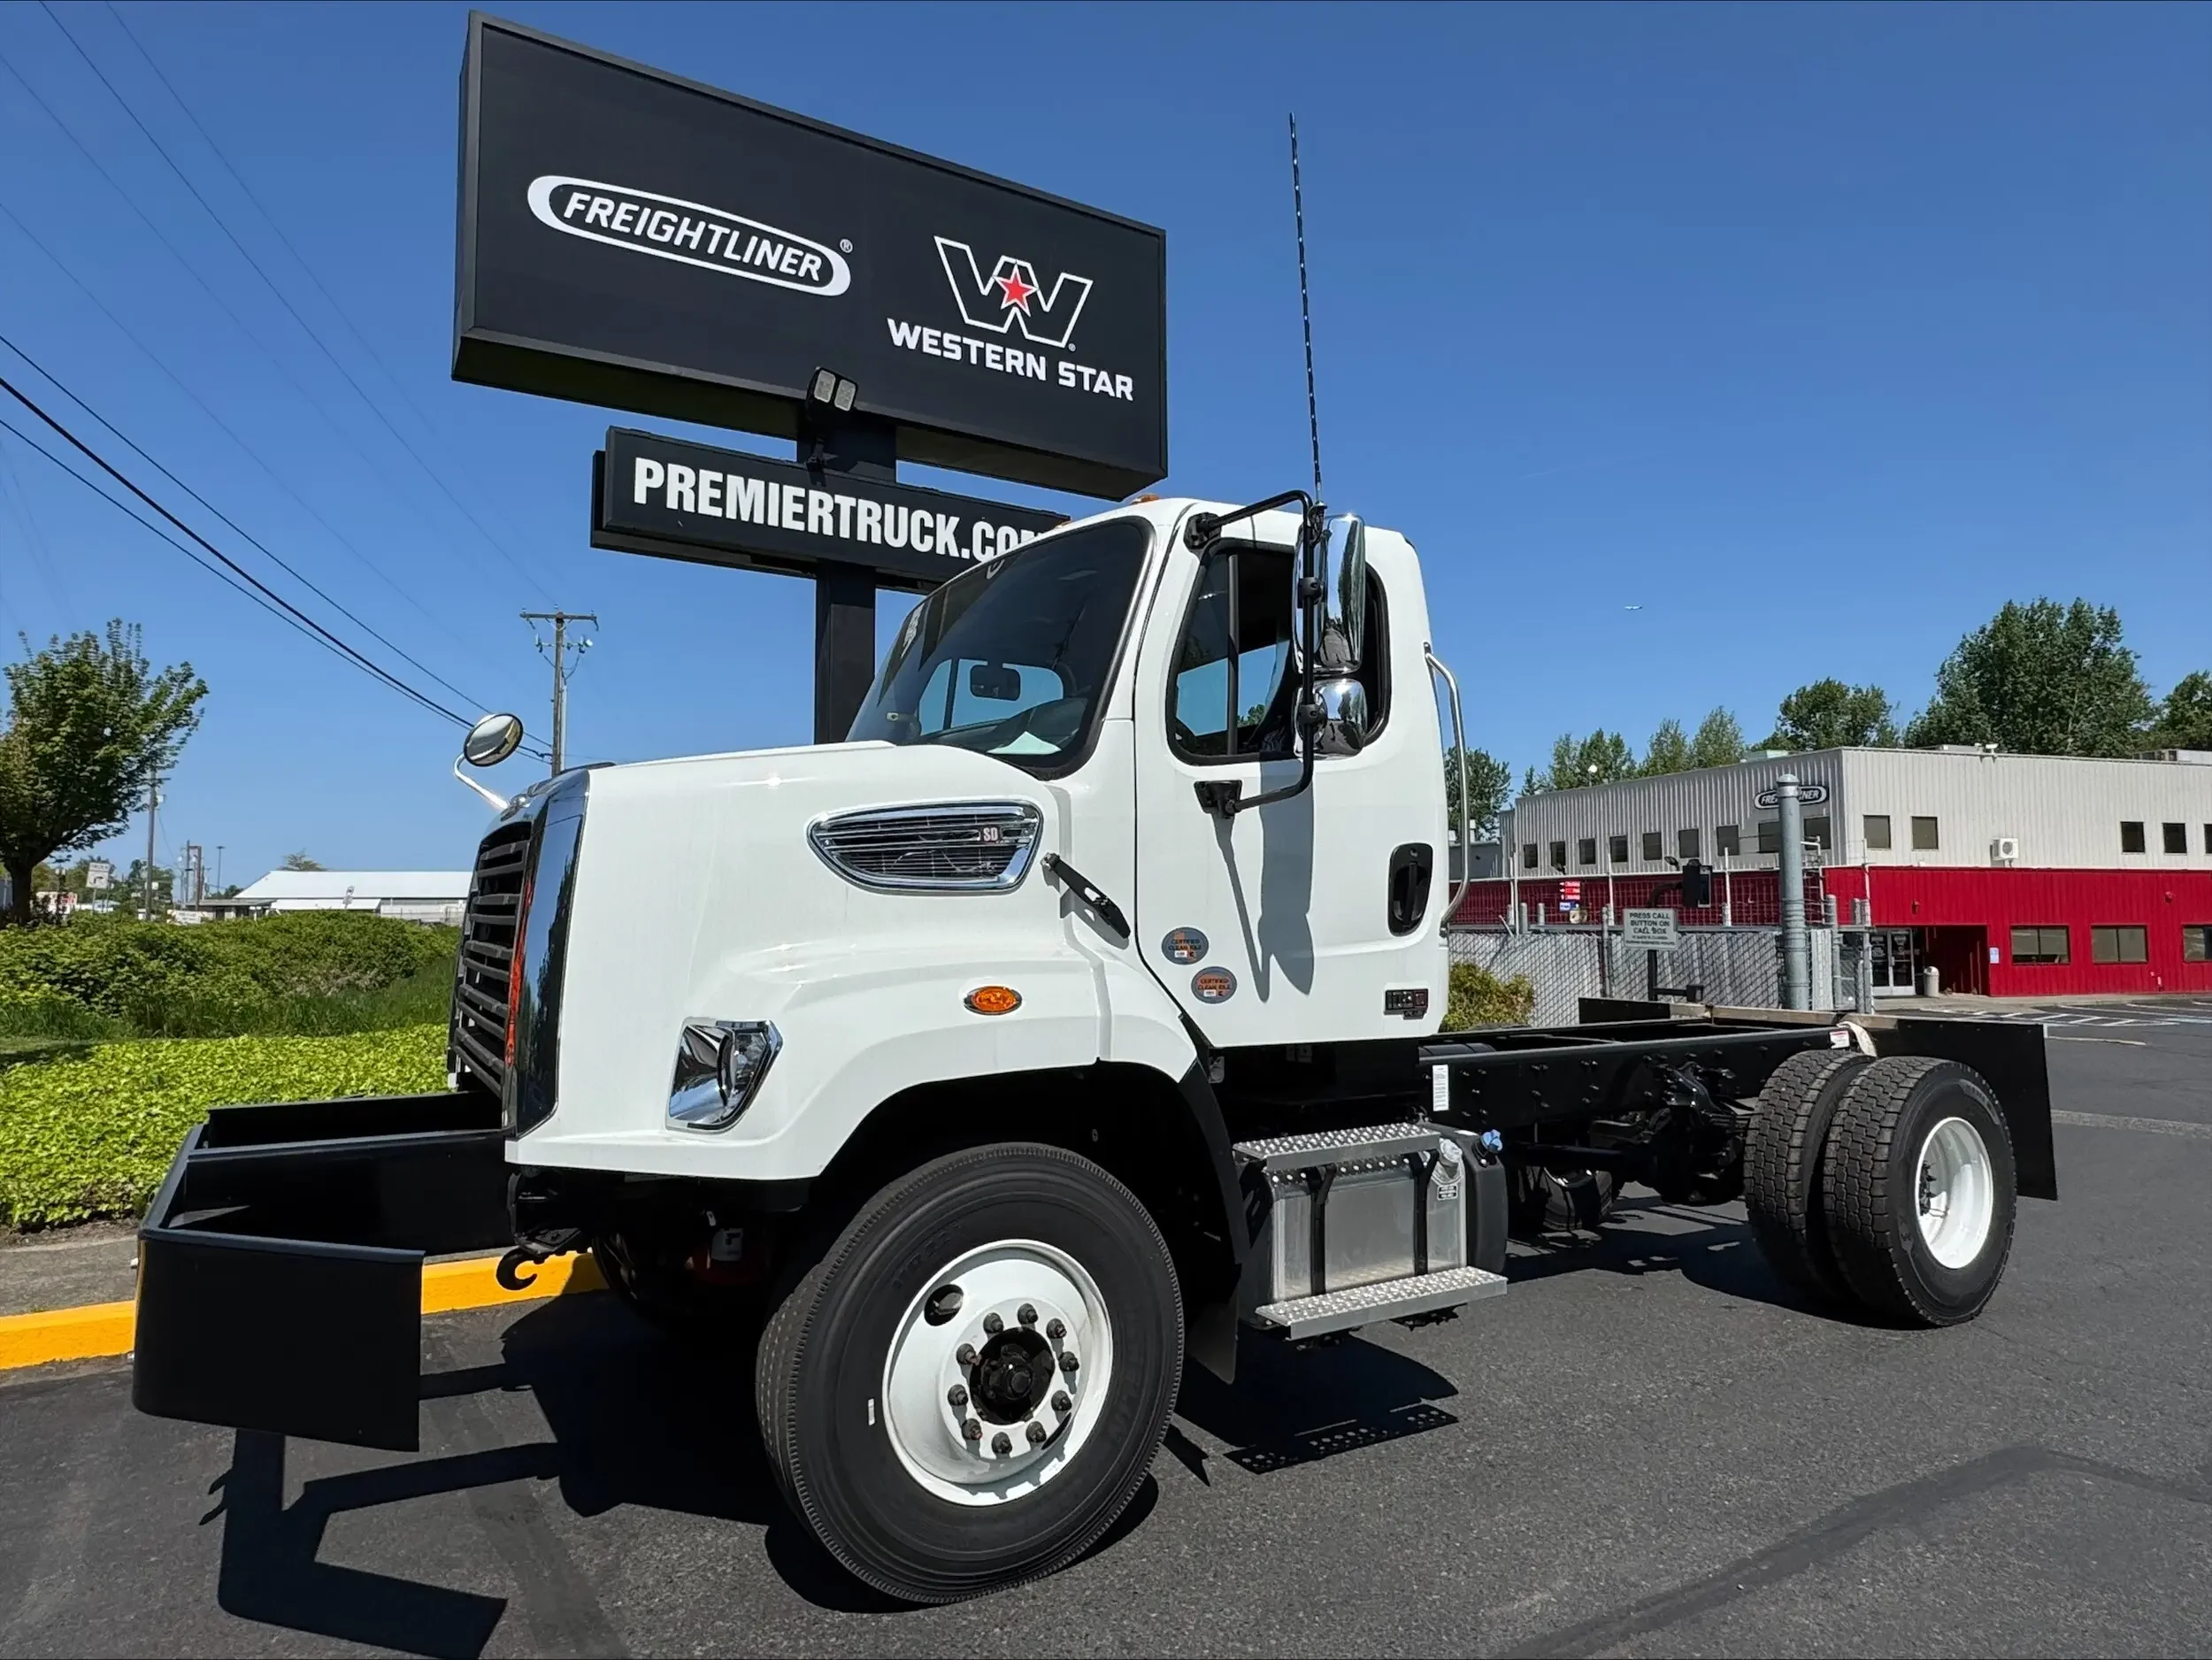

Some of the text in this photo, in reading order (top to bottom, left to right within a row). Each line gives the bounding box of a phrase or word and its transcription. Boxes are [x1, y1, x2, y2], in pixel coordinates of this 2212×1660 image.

[563, 191, 822, 282] FREIGHTLINER
[887, 318, 1133, 402] WESTERN STAR
[634, 457, 1045, 563] PREMIERTRUCK.CO
[983, 826, 999, 842] SD
